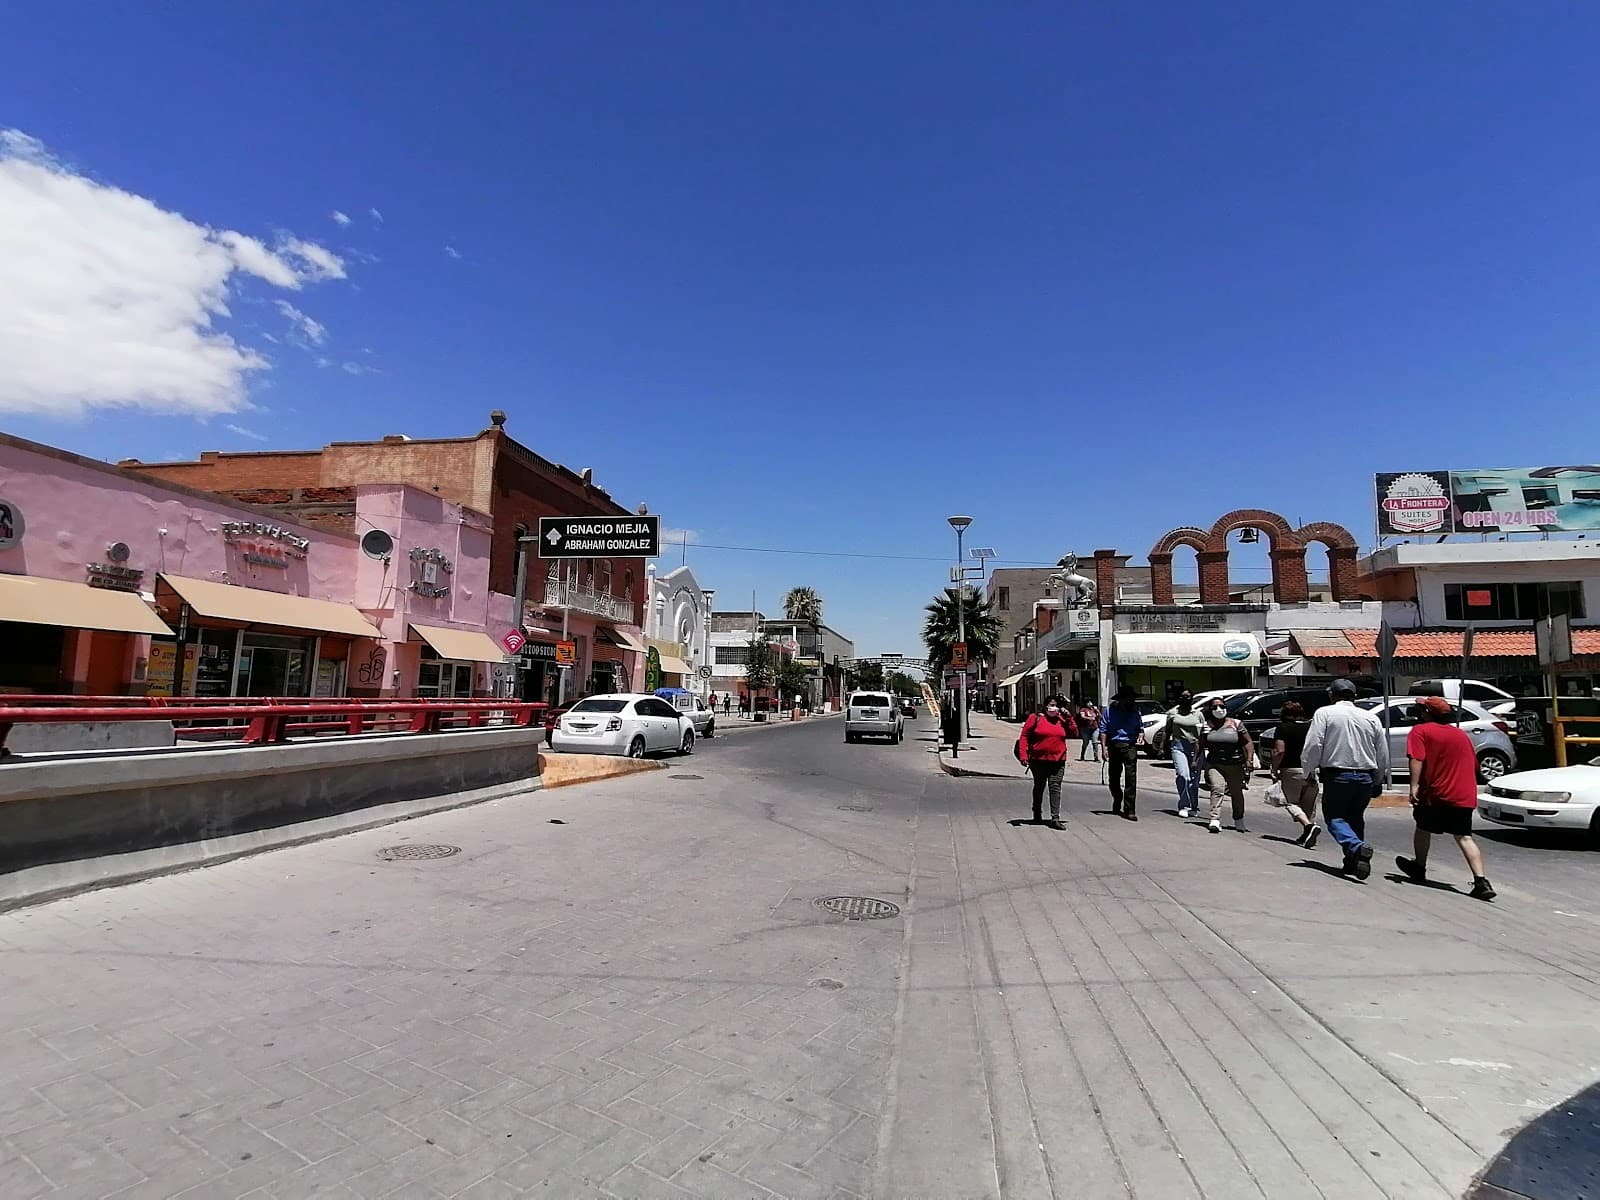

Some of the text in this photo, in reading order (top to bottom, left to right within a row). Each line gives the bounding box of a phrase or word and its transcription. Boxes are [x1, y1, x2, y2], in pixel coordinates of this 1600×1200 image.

[1390, 499, 1444, 509] LA FRONTERA
[1463, 511, 1501, 528] OPEN
[1503, 511, 1523, 525] 24
[566, 523, 650, 535] IGNACIO MEJIA
[564, 539, 651, 550] ABRAHAM GONZALEZ
